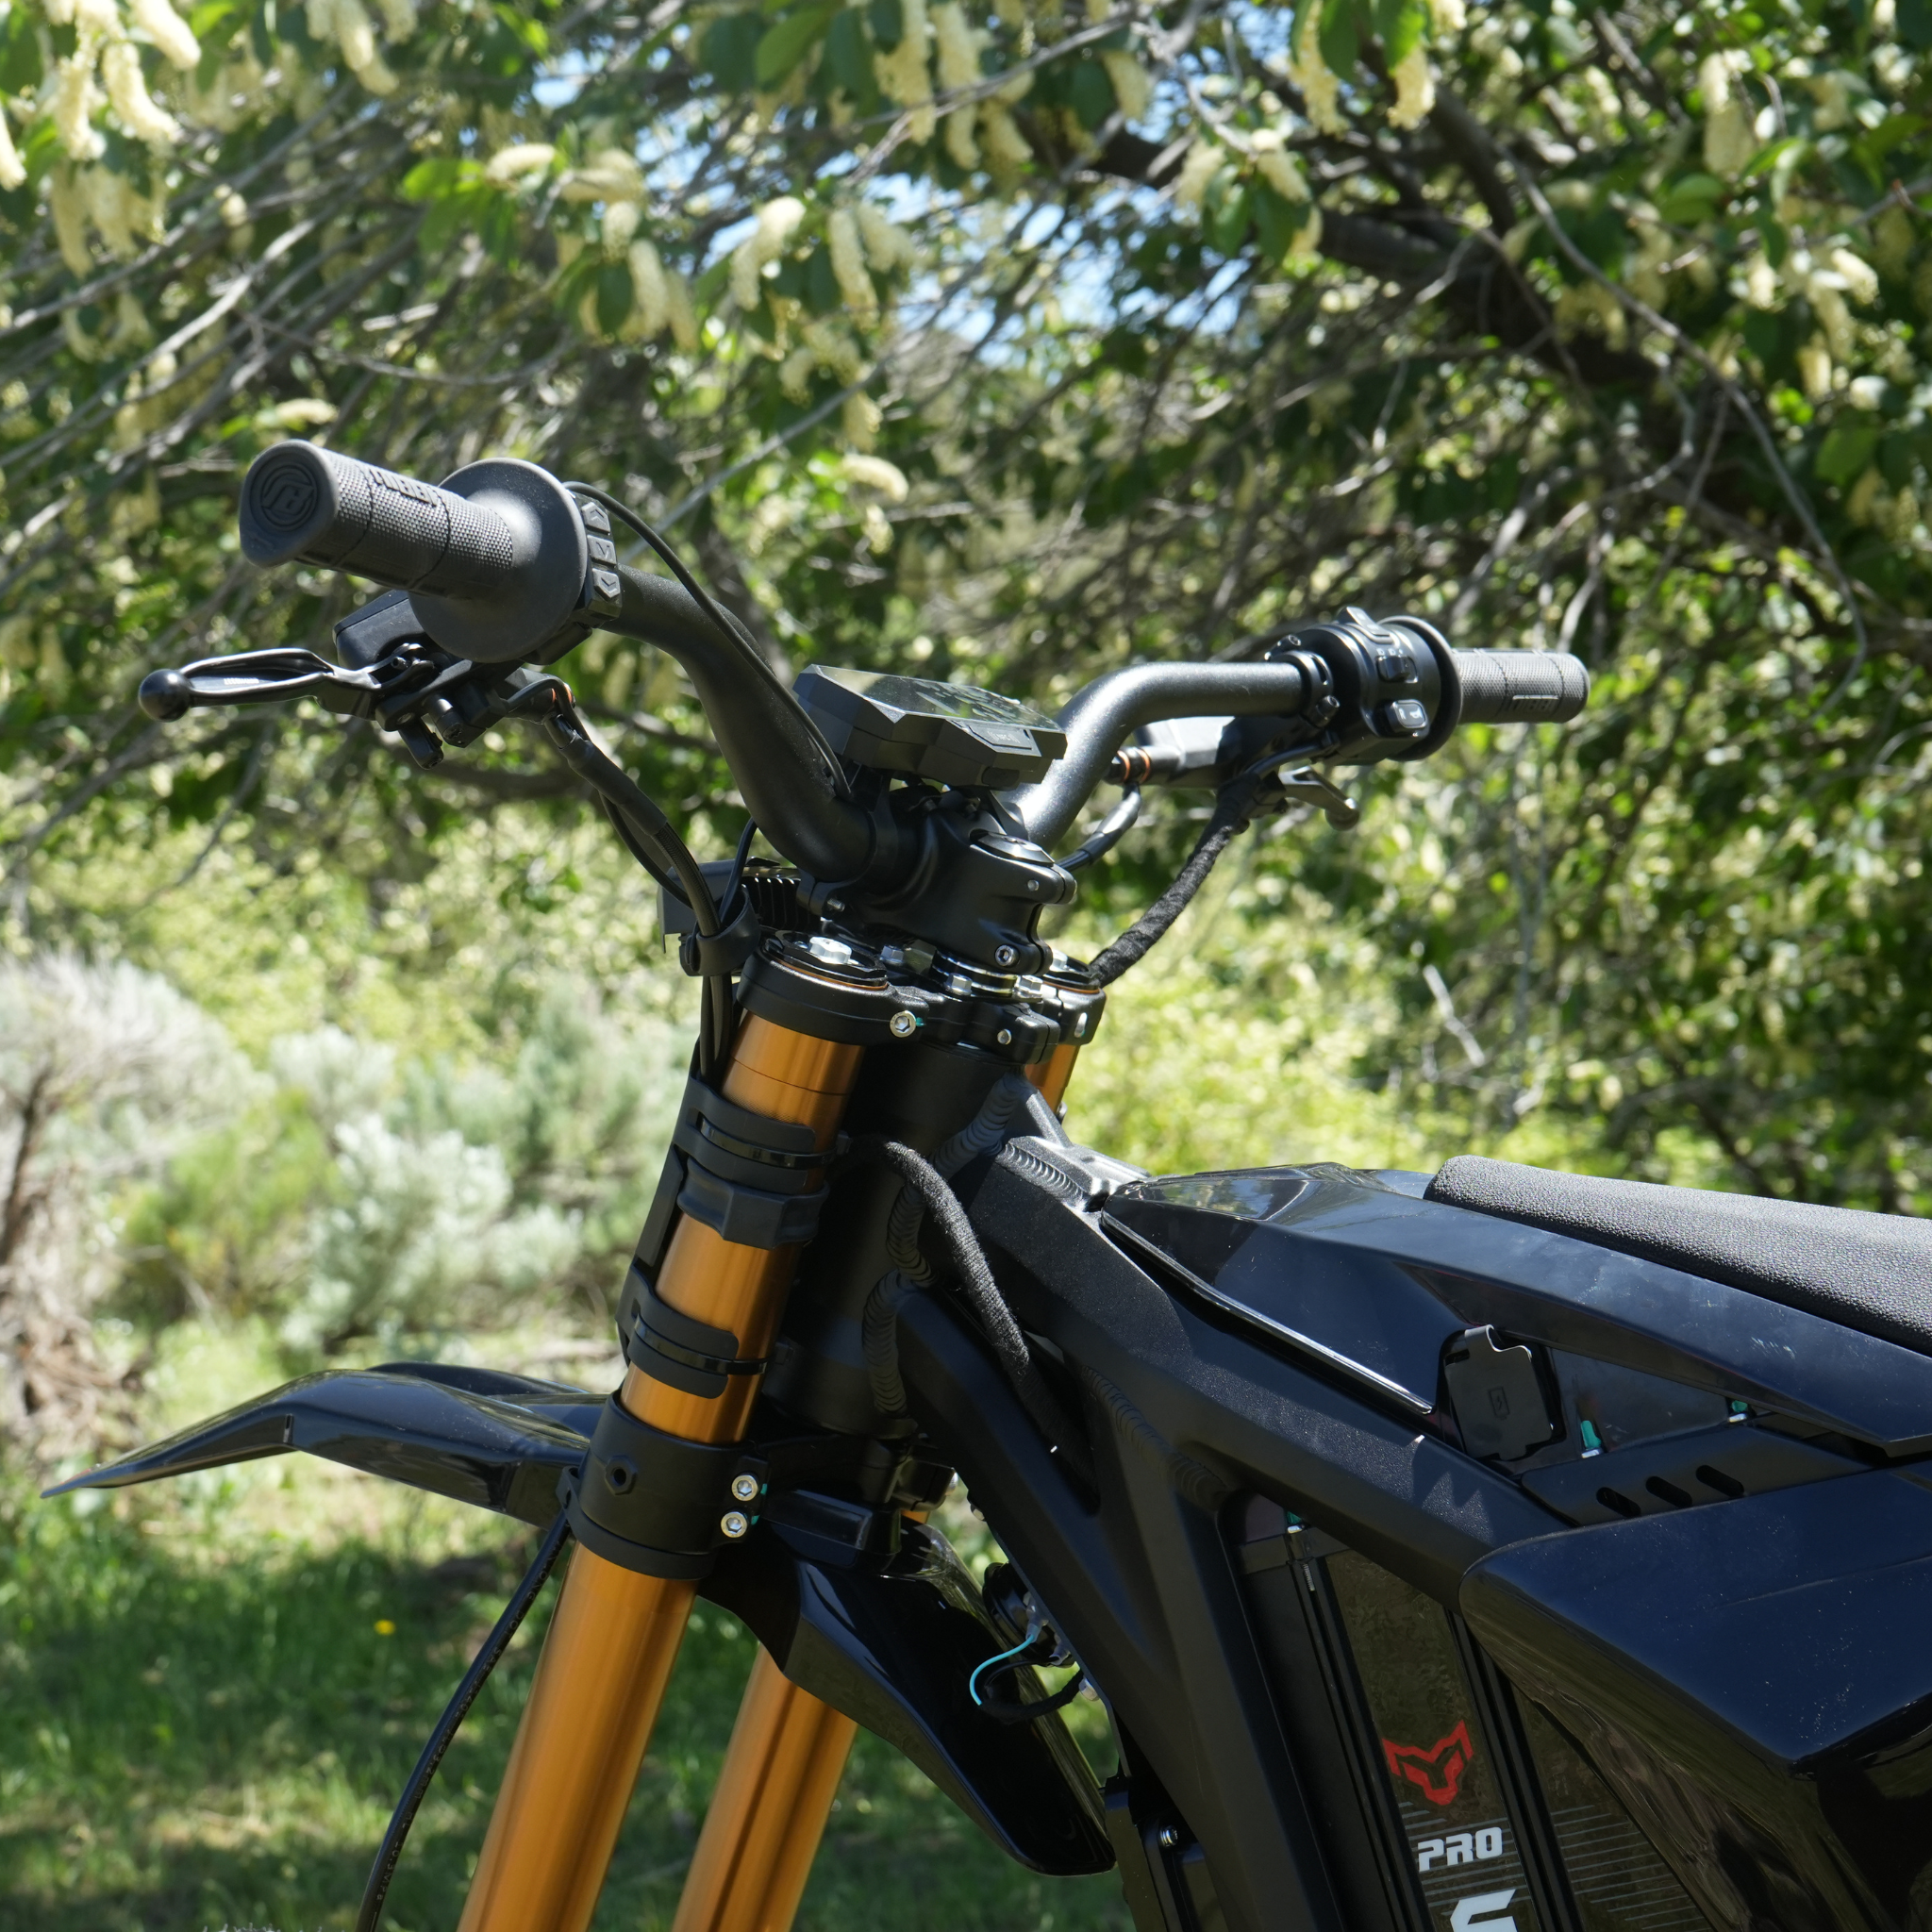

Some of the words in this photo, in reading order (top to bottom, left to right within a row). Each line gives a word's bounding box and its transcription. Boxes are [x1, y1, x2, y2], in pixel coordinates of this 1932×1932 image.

[502, 1608, 525, 1638] DOT
[481, 1645, 503, 1673] SAE
[1417, 1826, 1503, 1873] PRO
[375, 1840, 403, 1902] 10.3MPa
